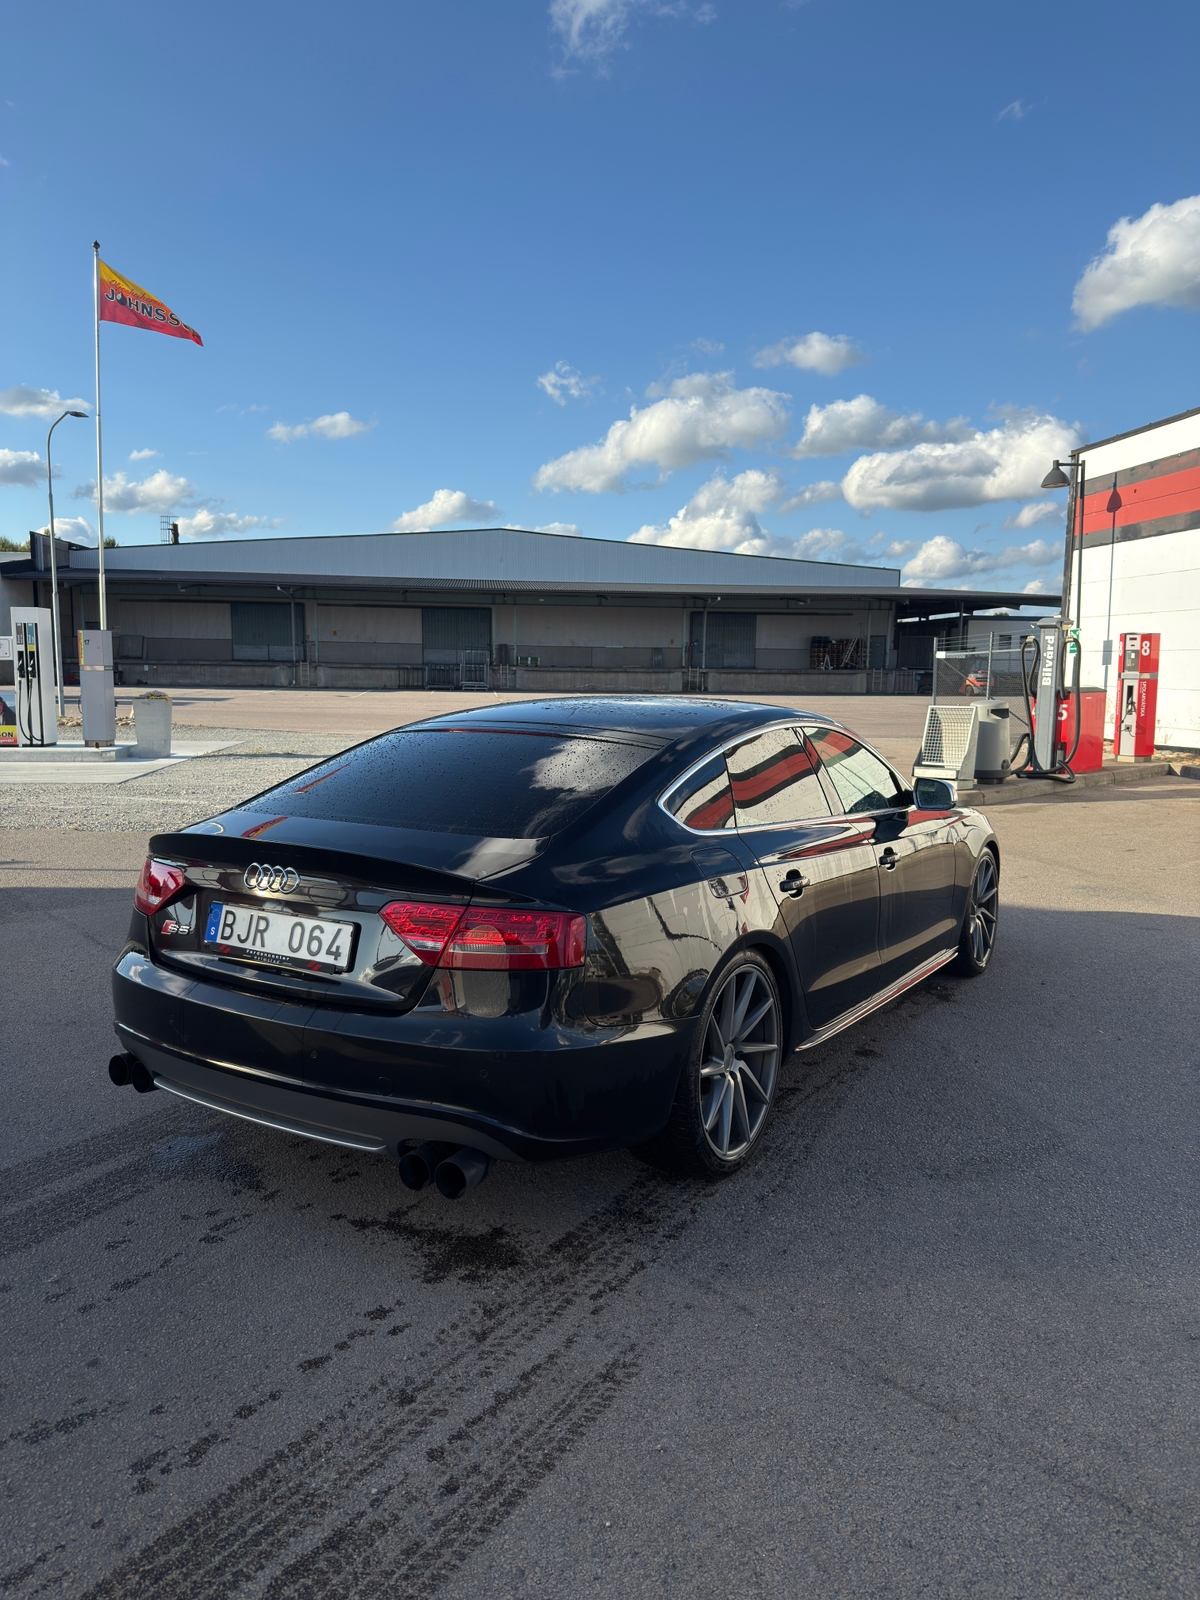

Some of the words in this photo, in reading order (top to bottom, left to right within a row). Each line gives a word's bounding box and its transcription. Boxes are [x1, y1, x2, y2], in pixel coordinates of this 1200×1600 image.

[1141, 640, 1151, 656] 8
[1041, 635, 1055, 686] Bilvård
[1057, 704, 1068, 721] 5
[166, 923, 191, 936] S5
[210, 926, 216, 936] S
[220, 909, 270, 948] BJR
[288, 921, 343, 961] 064
